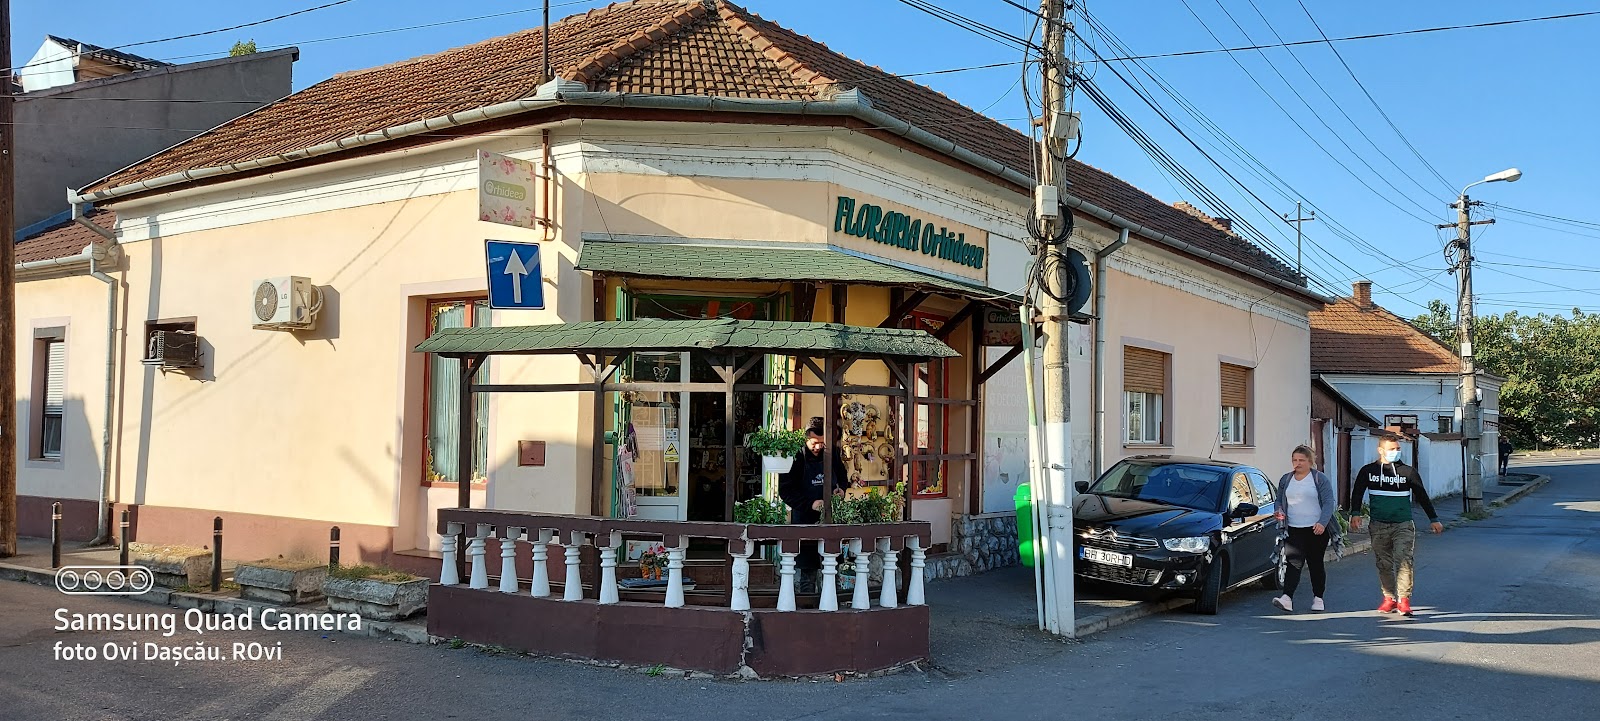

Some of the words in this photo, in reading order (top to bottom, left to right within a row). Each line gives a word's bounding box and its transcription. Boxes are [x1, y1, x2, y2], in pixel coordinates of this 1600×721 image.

[486, 180, 524, 200] Orhideea
[834, 195, 922, 252] FLORARIA
[921, 222, 985, 270] Orhideea
[989, 312, 1020, 323] Orhidee
[1369, 472, 1380, 483] Los
[1381, 473, 1407, 486] Angeles
